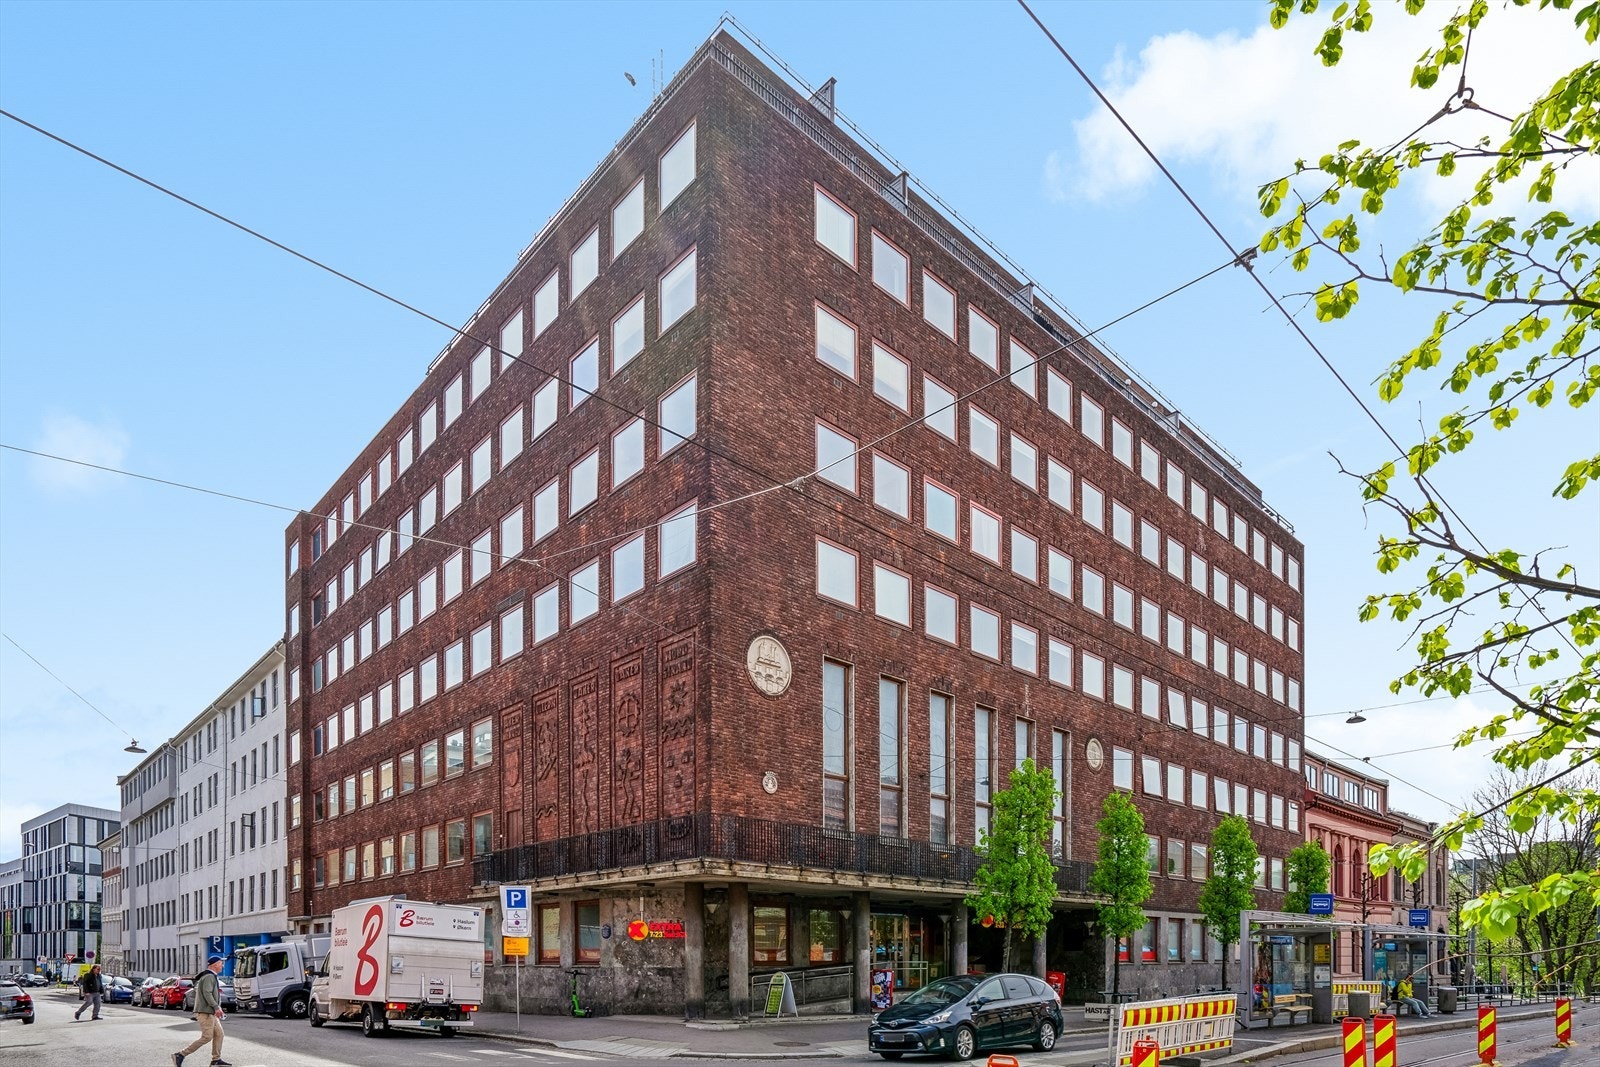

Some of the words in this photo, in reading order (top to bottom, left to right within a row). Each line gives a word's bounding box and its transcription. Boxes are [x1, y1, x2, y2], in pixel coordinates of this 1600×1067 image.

[511, 891, 522, 906] P
[400, 910, 415, 927] B
[649, 922, 682, 931] EXTRA
[213, 936, 221, 945] P
[355, 904, 384, 996] B
